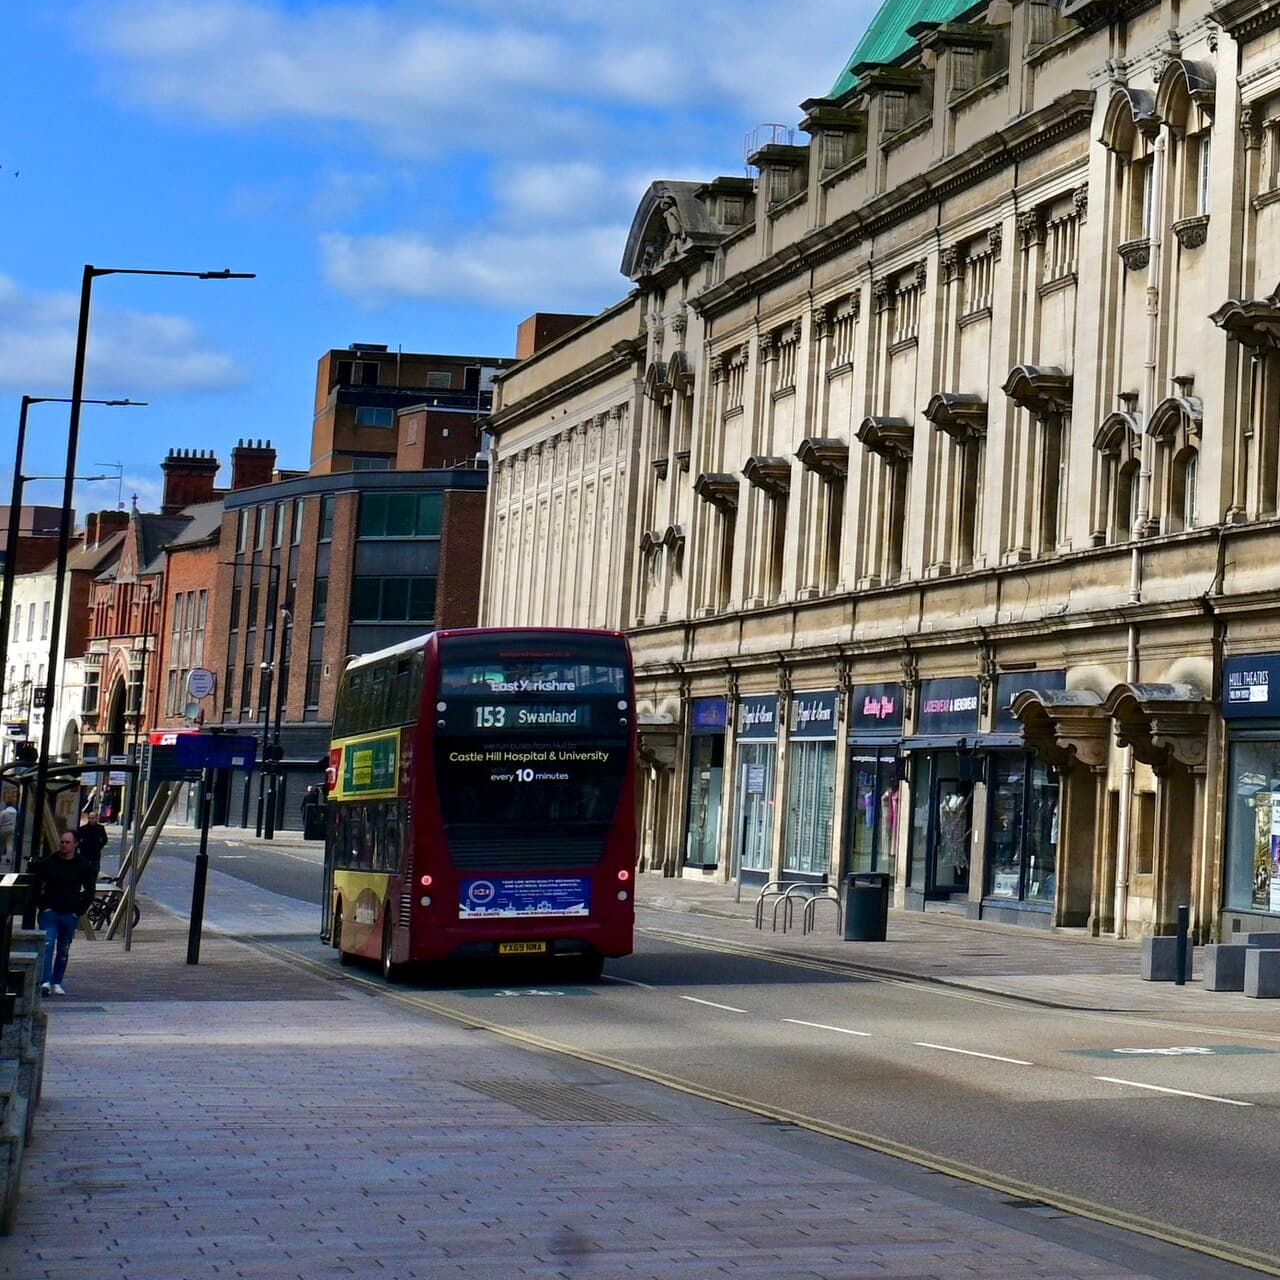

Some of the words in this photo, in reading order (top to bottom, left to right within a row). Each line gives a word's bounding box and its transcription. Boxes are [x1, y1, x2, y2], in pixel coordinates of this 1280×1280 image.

[1229, 672, 1243, 686] HULL
[1243, 670, 1269, 686] THEATRES
[475, 705, 506, 728] 153
[518, 709, 577, 724] Swanland
[449, 751, 484, 762] Castle
[486, 751, 502, 762] Hill
[504, 751, 547, 763] Hospital
[549, 751, 557, 761] &
[559, 751, 609, 762] University
[490, 773, 514, 783] every
[515, 769, 534, 782] 10
[535, 772, 569, 781] minutes
